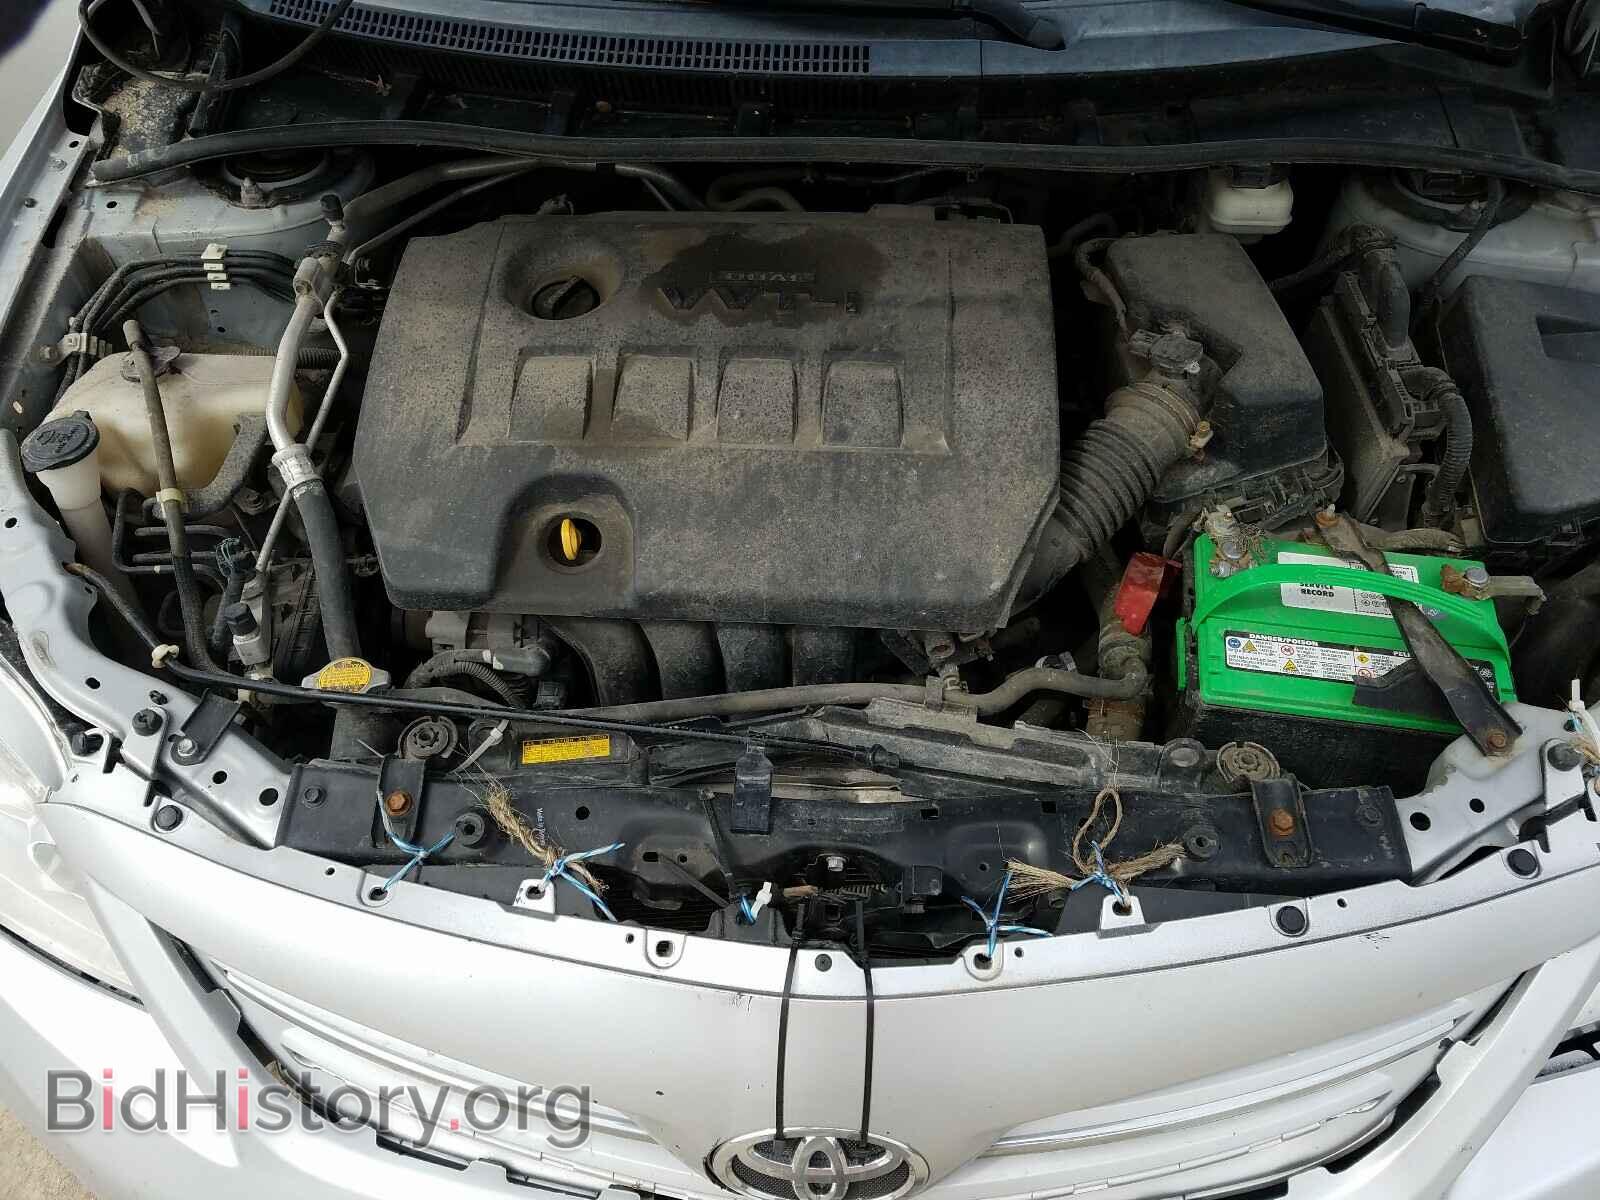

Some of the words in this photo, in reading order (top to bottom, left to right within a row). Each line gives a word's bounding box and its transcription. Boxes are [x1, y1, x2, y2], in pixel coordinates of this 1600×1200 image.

[1300, 588, 1335, 598] RECORD
[1248, 633, 1319, 647] DANGER/POISON
[1393, 650, 1411, 658] PELI
